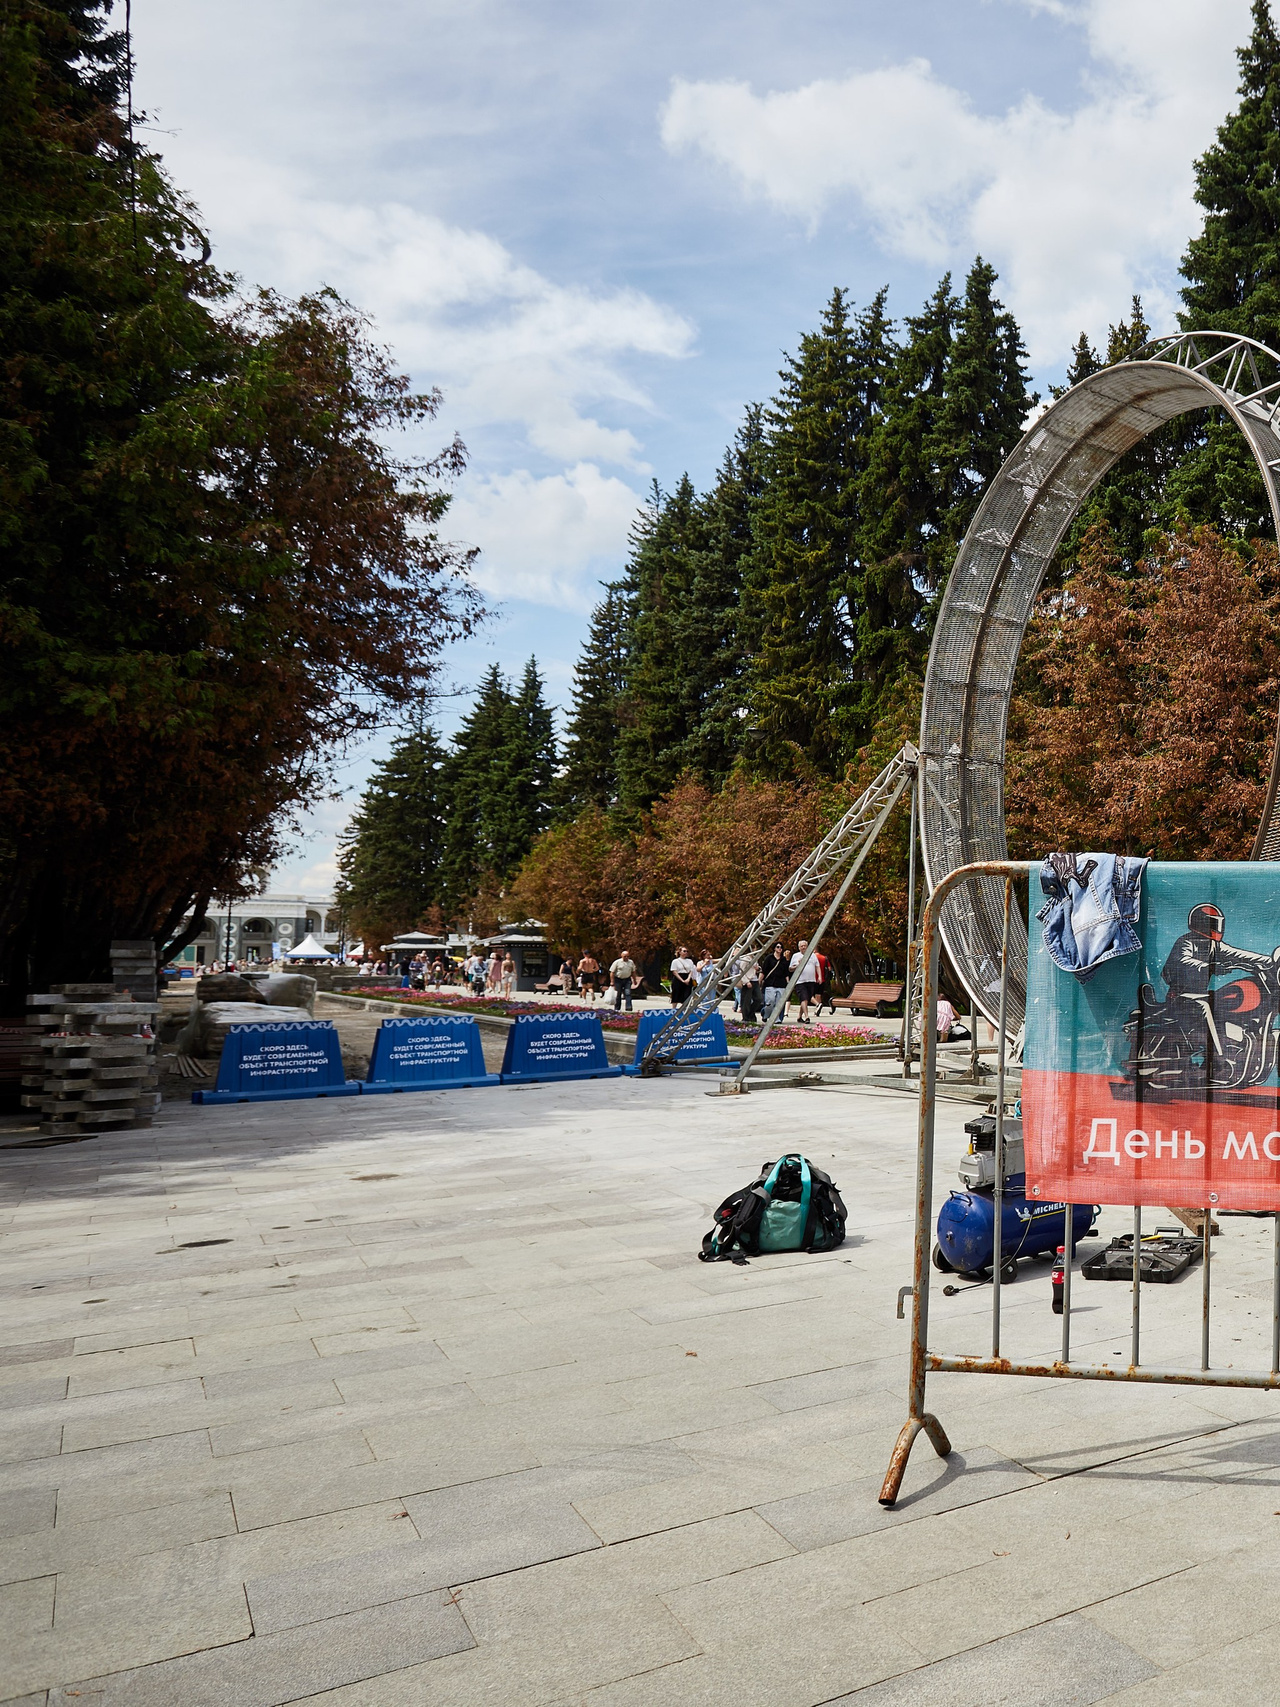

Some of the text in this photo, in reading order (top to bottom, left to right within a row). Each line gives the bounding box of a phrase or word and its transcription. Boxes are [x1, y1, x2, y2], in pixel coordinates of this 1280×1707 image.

[414, 1041, 465, 1050] СОВРЕМЕННЫЙ
[548, 1038, 592, 1046] СОВРЕМЕННЫЙ
[550, 1044, 595, 1052] ТРАНСПОРТНОЙ
[267, 1050, 325, 1060] СОВРЕМЕННЫЙ
[417, 1049, 468, 1057] ТРАНСПОРТНОЙ
[270, 1058, 329, 1067] ТРАНСПОРТНОЙ
[400, 1057, 460, 1066] ИНФРАСТРУКТУРЫ
[250, 1067, 318, 1076] ИНФРАСТРУКТУРЫ
[1082, 1117, 1206, 1166] День
[1033, 1202, 1066, 1214] MICHELI
